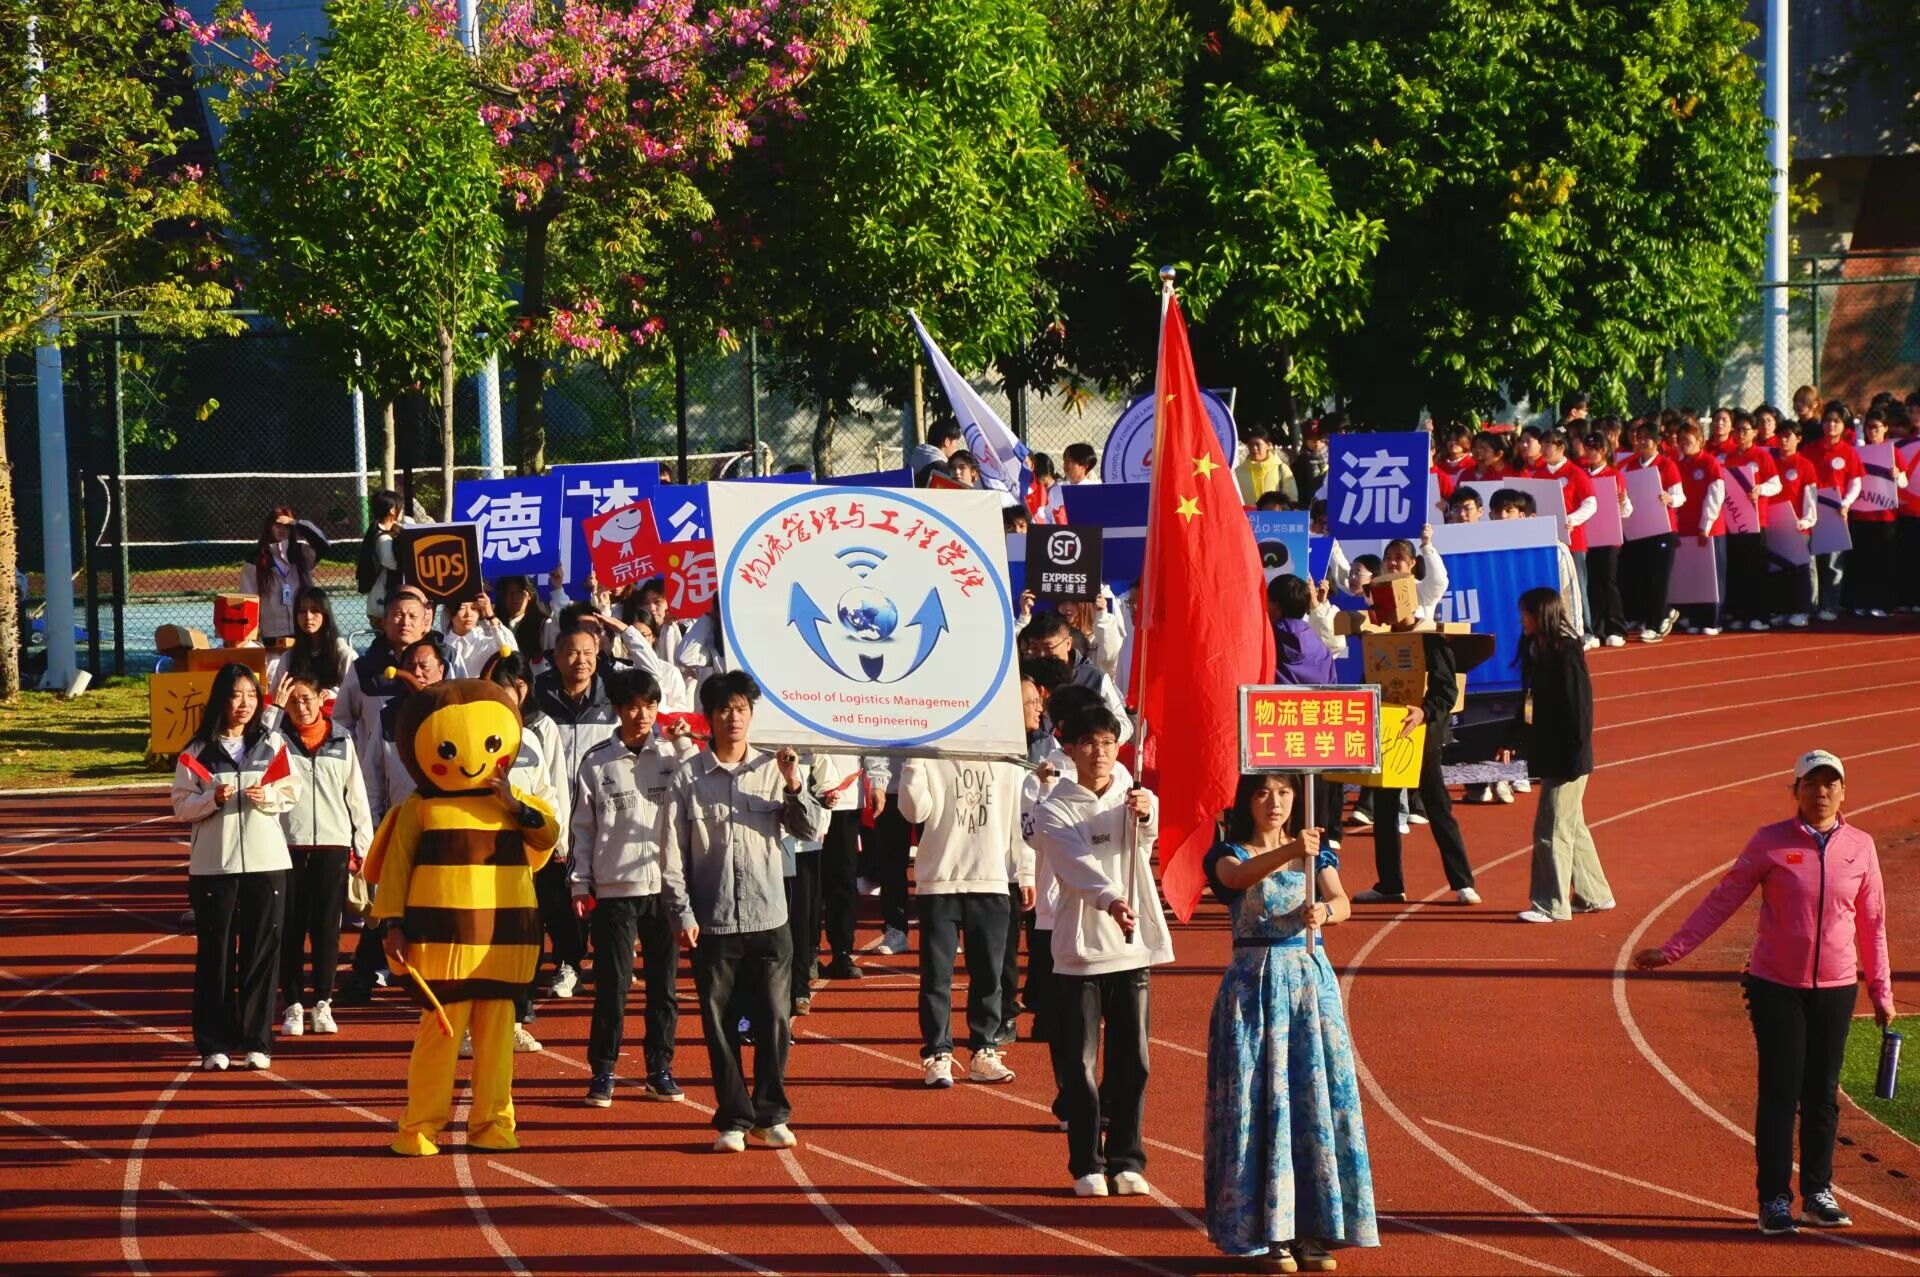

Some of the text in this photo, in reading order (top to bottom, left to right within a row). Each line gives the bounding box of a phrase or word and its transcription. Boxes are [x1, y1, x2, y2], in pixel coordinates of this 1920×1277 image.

[1339, 449, 1410, 525] 流
[466, 492, 542, 562] 德
[419, 553, 464, 586] ups
[611, 555, 655, 584] 京东
[1042, 572, 1087, 584] EXPRESS
[782, 690, 970, 709] School of Logistics Management
[1255, 699, 1366, 727] 物流管理与
[832, 713, 928, 729] and Engineering
[1255, 731, 1366, 758] 工程学院
[955, 768, 993, 805] LOVE
